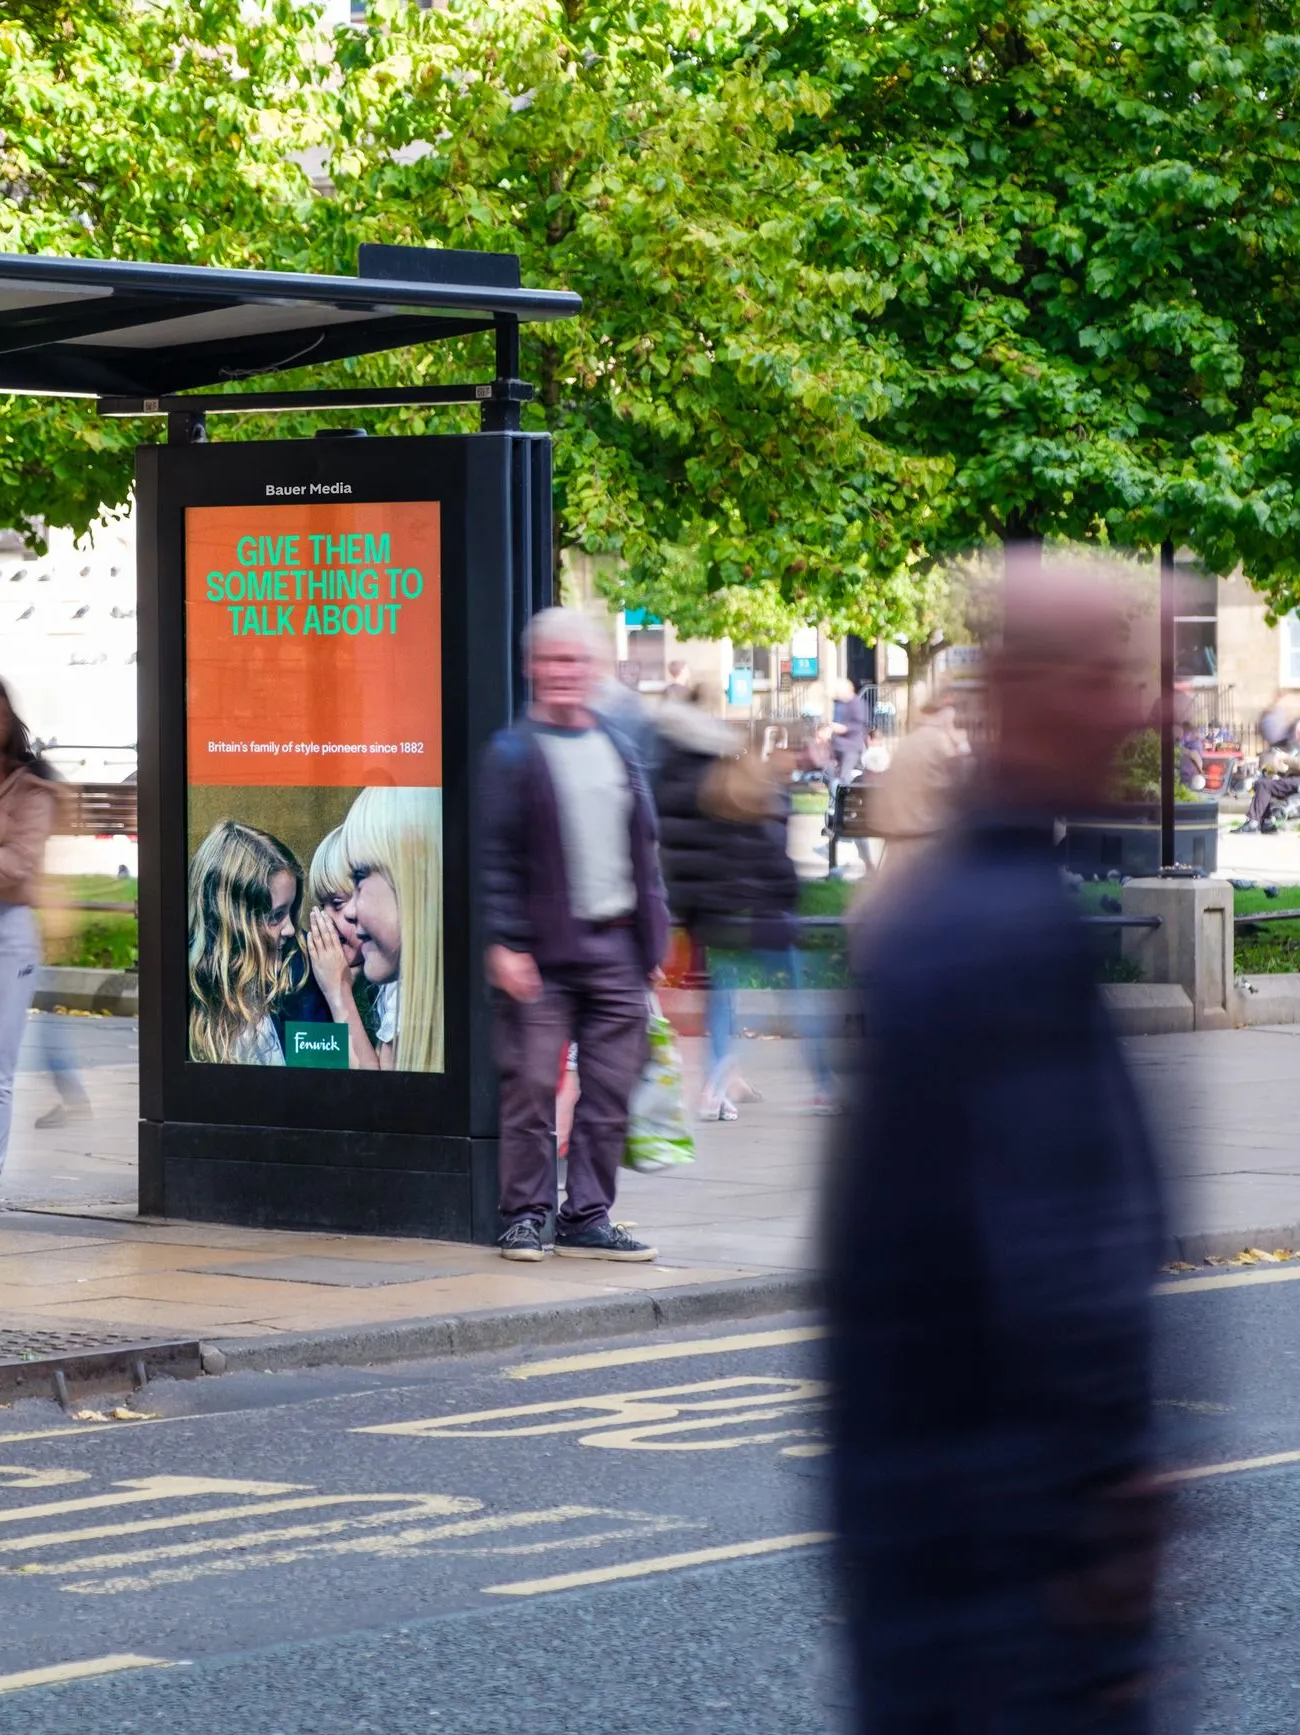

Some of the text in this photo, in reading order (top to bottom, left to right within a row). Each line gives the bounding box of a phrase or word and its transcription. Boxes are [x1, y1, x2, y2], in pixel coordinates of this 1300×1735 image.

[265, 482, 353, 496] Bauer Media
[236, 533, 391, 566] GIVE THEM
[206, 568, 424, 602] SOMETHING TO
[227, 604, 402, 636] TALK ABOUT
[208, 741, 424, 755] Britain's family of style pioneers since 1882
[294, 1031, 340, 1053] Fenwick
[348, 1376, 836, 1458] BU
